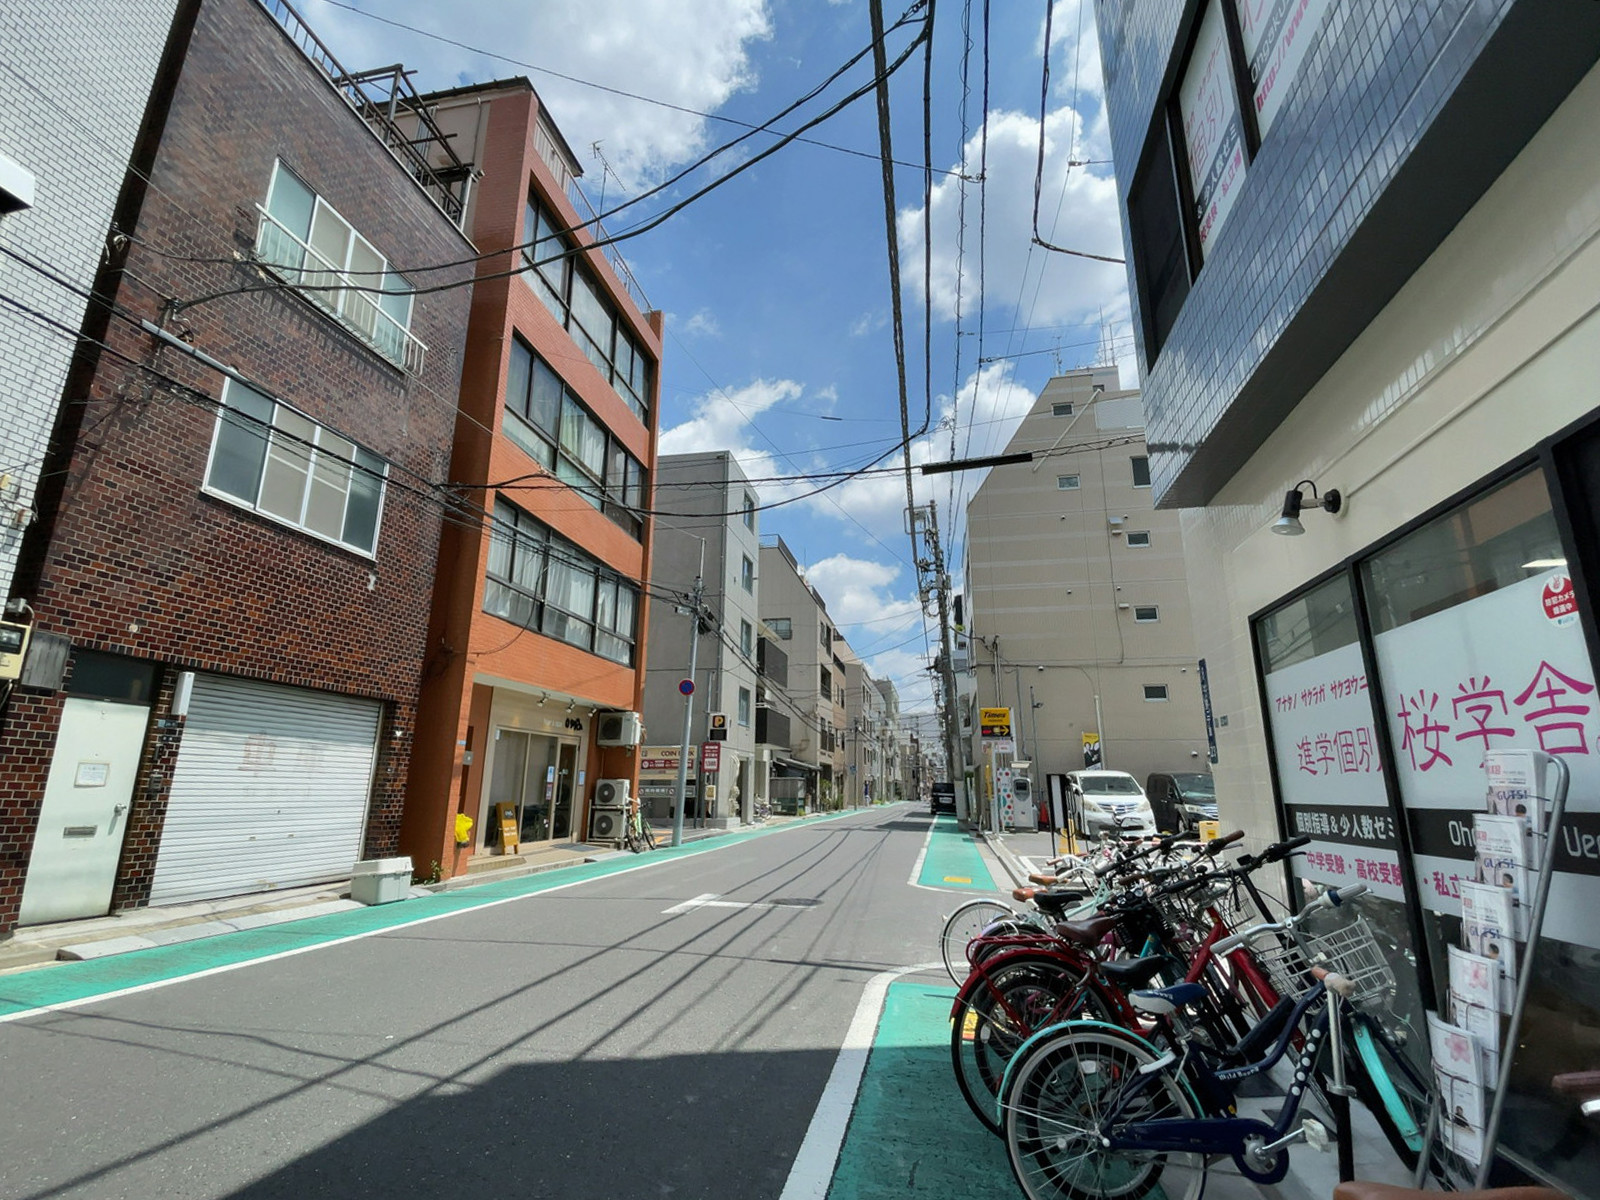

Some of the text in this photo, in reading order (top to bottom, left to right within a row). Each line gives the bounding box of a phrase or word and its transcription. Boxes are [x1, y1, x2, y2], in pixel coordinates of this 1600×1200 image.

[1275, 675, 1368, 713] アナタノ サクラガ サクヨウニ
[1397, 660, 1595, 772] 桜学舎
[1295, 726, 1383, 776] 進学個別
[1295, 811, 1395, 840] 個別指導&少人数ゼミ
[1448, 820, 1600, 858] Oh Ue
[1306, 851, 1403, 887] 中学受験・高校受験
